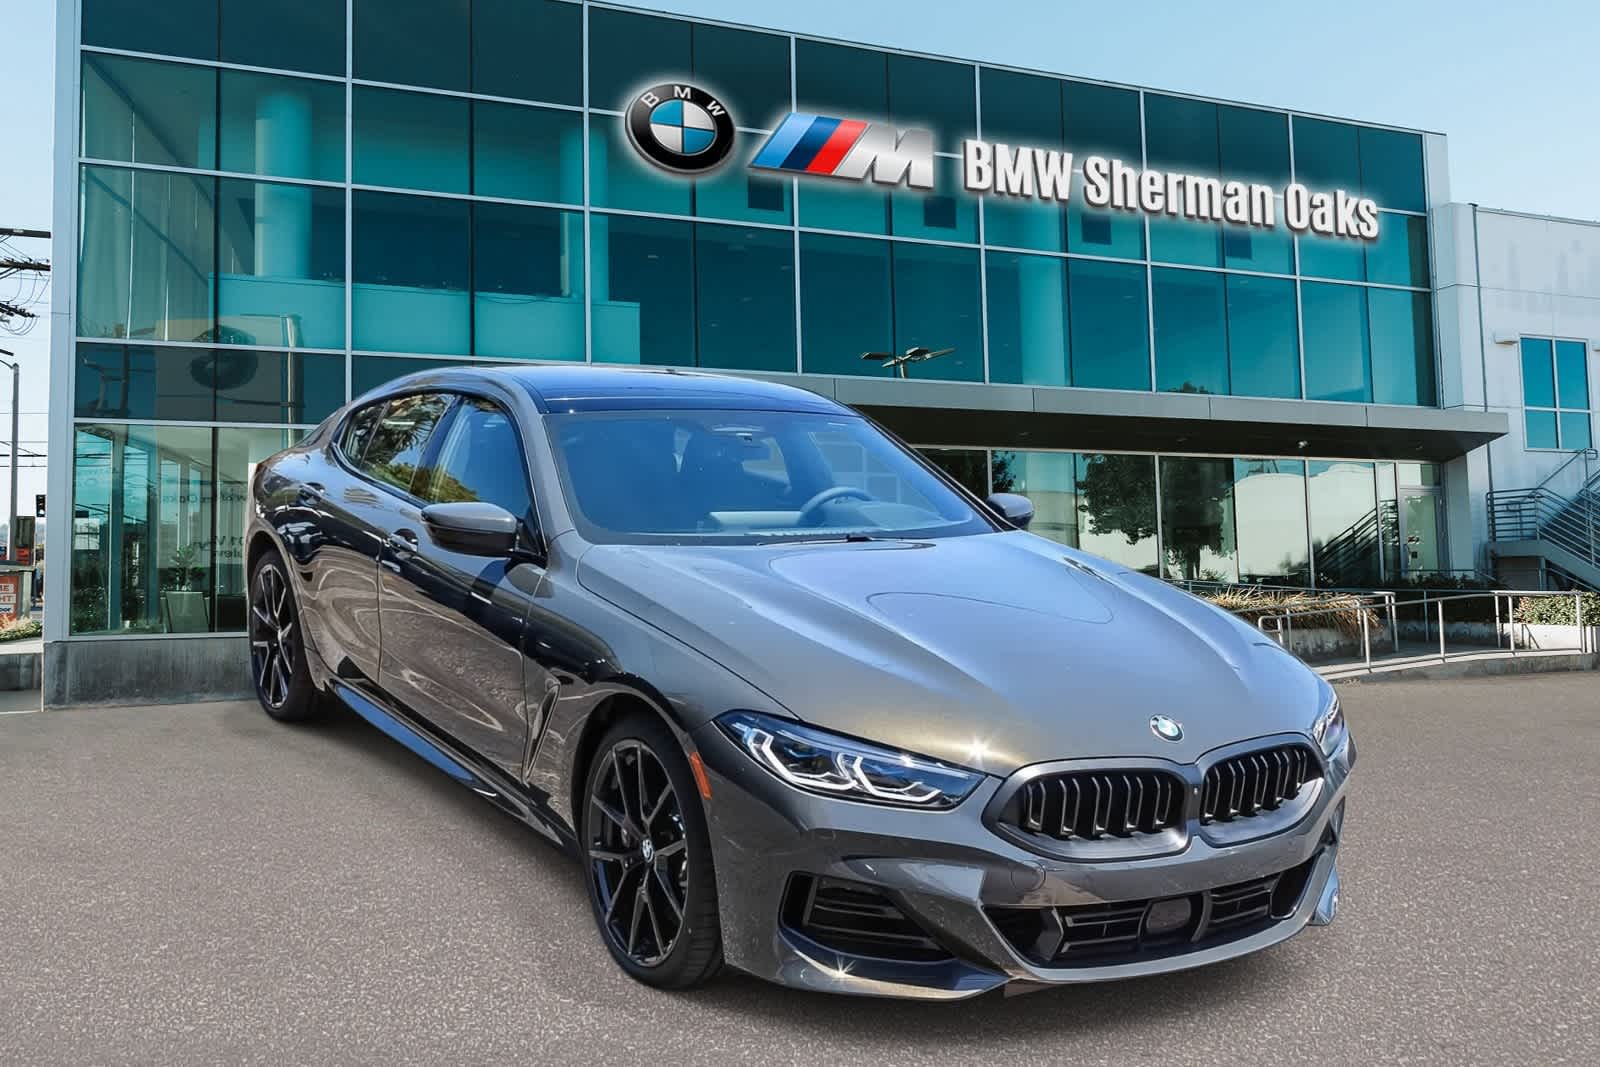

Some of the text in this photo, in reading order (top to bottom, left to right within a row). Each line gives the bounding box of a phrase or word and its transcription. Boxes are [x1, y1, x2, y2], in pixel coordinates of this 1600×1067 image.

[641, 85, 725, 117] BMW
[822, 121, 935, 189] M
[963, 138, 1379, 241] BMW Sherman Oaks
